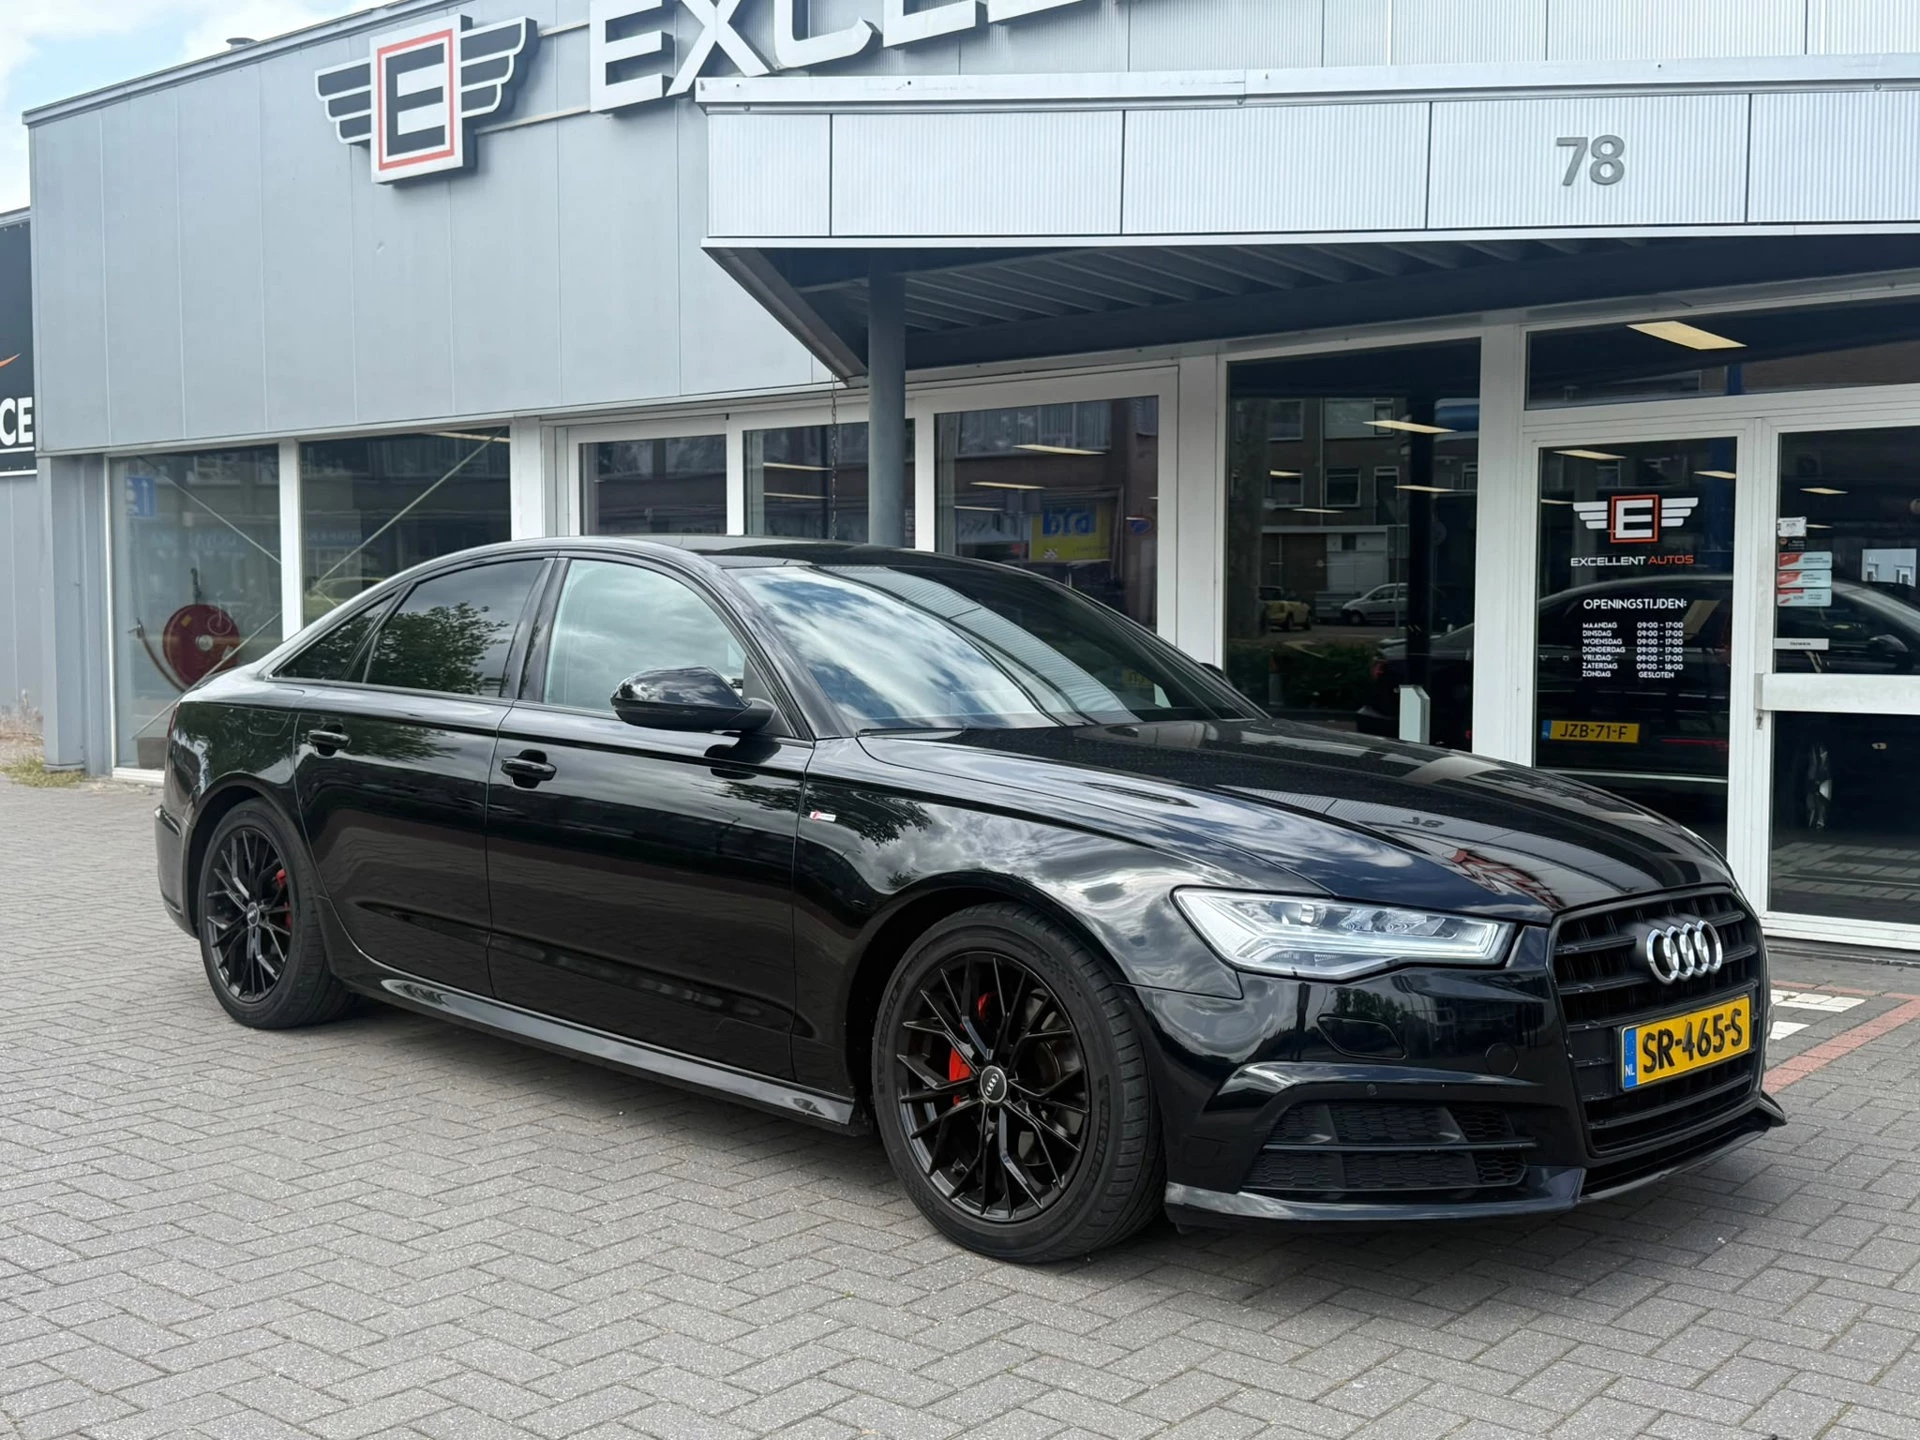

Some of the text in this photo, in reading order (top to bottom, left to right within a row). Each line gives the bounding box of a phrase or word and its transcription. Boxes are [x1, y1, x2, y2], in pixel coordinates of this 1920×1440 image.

[590, 0, 1086, 113] EXC
[1556, 134, 1625, 186] 78
[1570, 555, 1694, 567] EXCELLENT AUTOS
[1583, 598, 1687, 609] OPENINGSTIJDEN:
[1560, 723, 1628, 740] JZB-71-F
[1642, 1008, 1743, 1074] SR-465-S
[1625, 1064, 1635, 1076] NL
